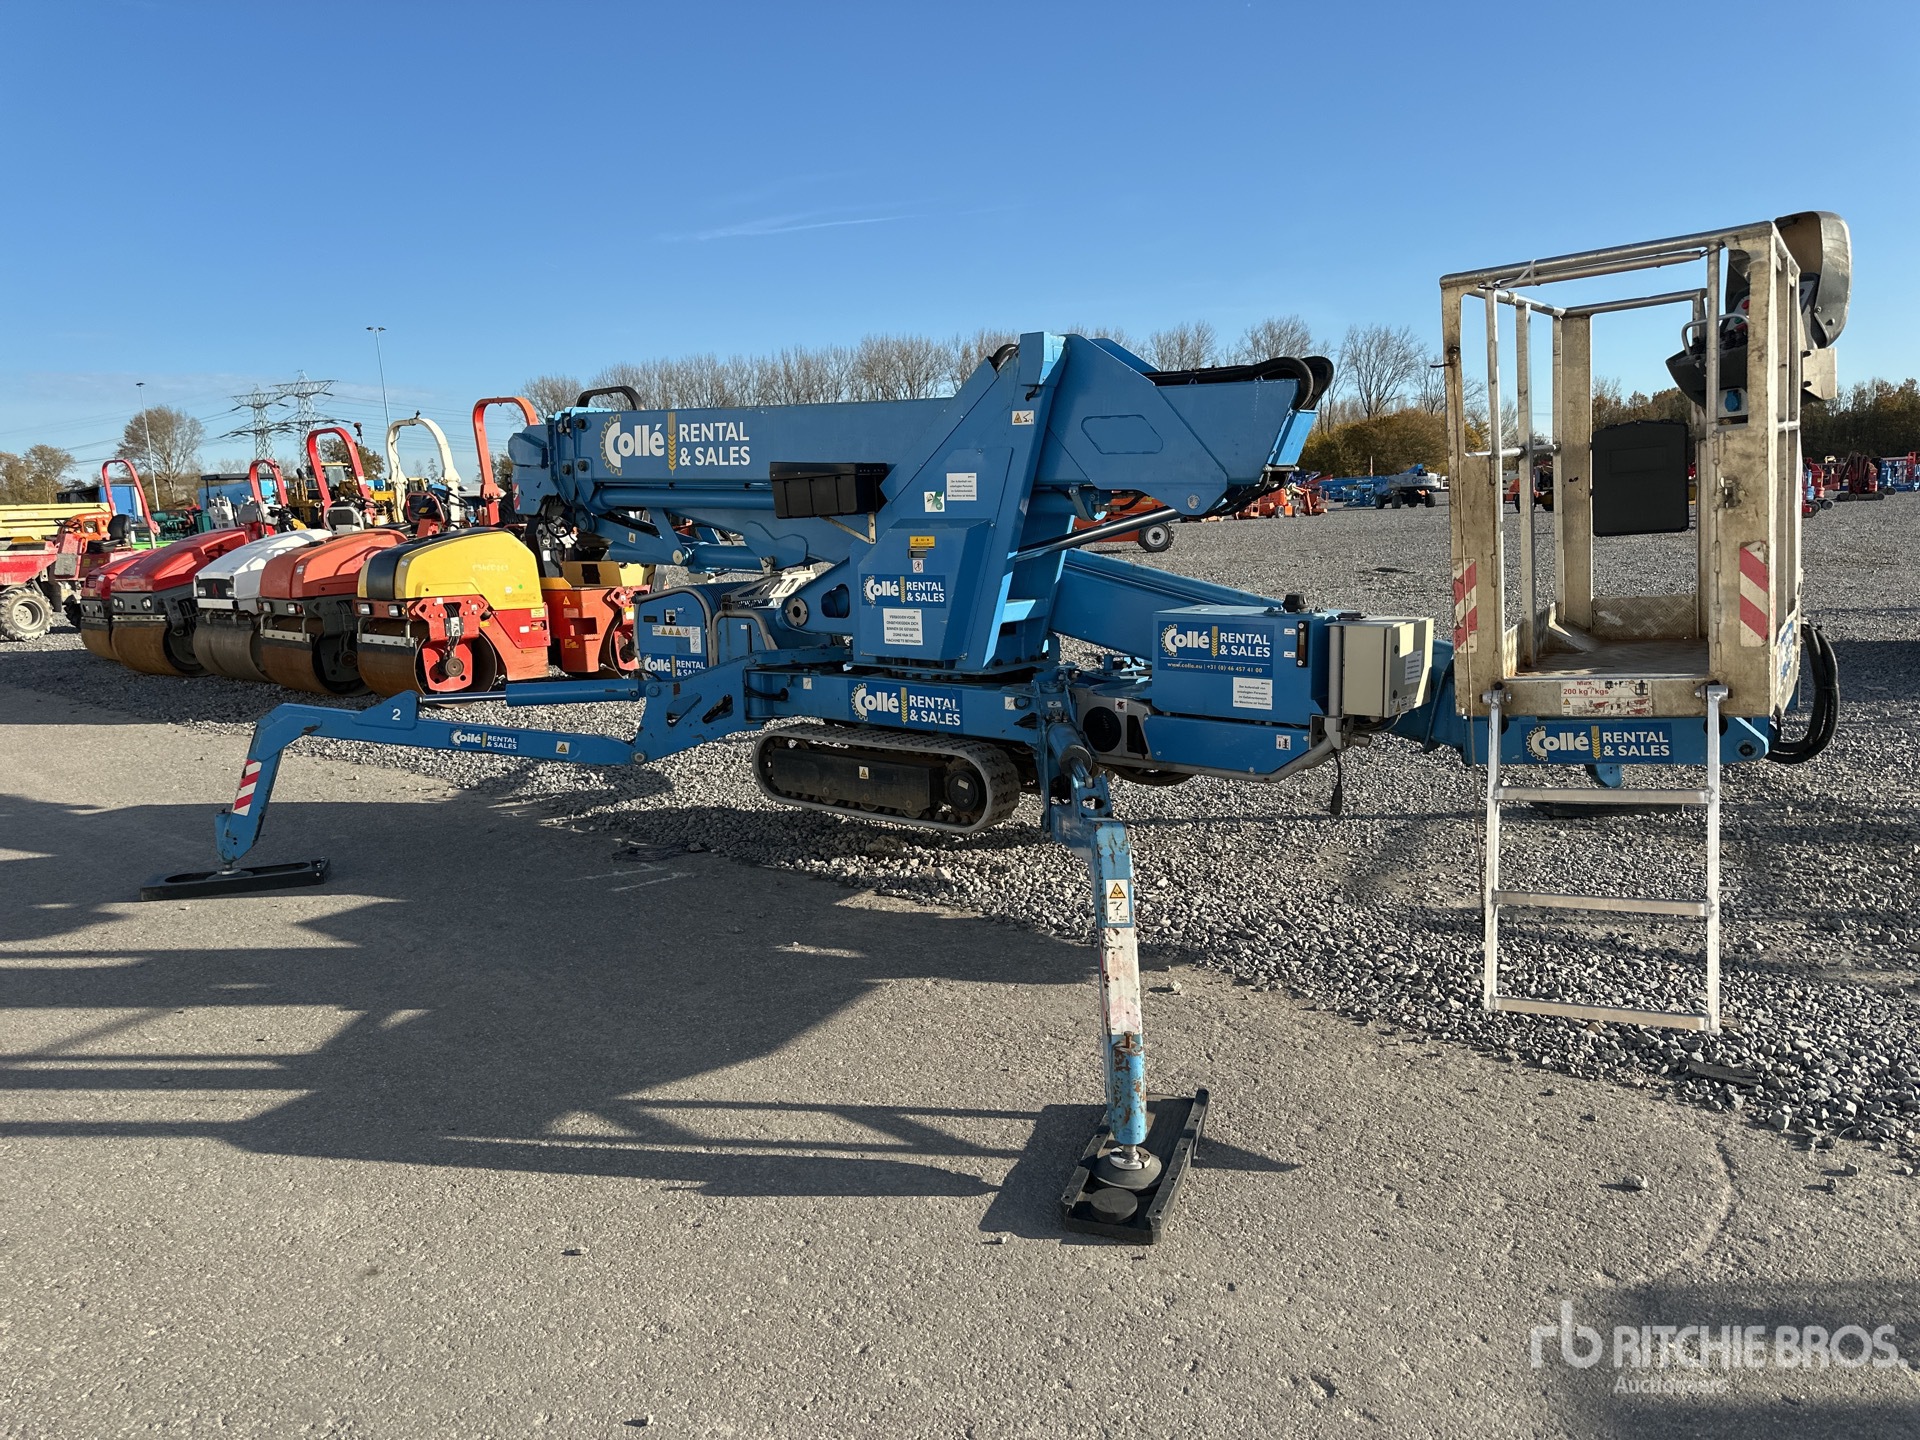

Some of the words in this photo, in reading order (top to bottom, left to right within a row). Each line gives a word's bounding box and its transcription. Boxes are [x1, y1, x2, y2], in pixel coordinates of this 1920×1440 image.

[679, 422, 750, 442] RENTAL
[604, 421, 665, 468] Collé
[679, 447, 692, 466] &
[695, 446, 751, 466] SALES
[866, 579, 899, 601] Collé
[906, 581, 945, 591] RENTAL
[906, 592, 914, 602] &
[915, 592, 945, 602] SALES
[1164, 628, 1210, 653] Collé
[1220, 632, 1271, 645] RENTAL
[1219, 645, 1228, 655] &
[1230, 645, 1271, 658] SALES
[645, 657, 671, 673] Collé
[676, 660, 706, 670] RENTAL
[676, 669, 683, 677] &
[1578, 688, 1588, 696] kg
[1595, 688, 1609, 696] kgs
[855, 688, 899, 717] Collé
[909, 695, 960, 712] RENTAL
[391, 708, 401, 721] 2
[909, 709, 919, 722] &
[920, 710, 961, 726] SALES
[487, 735, 518, 744] RENTAL
[1530, 730, 1589, 757] Collé
[1602, 731, 1669, 743] RENTAL
[493, 741, 517, 750] SALES
[1603, 745, 1615, 757] &
[1618, 744, 1670, 757] SALES
